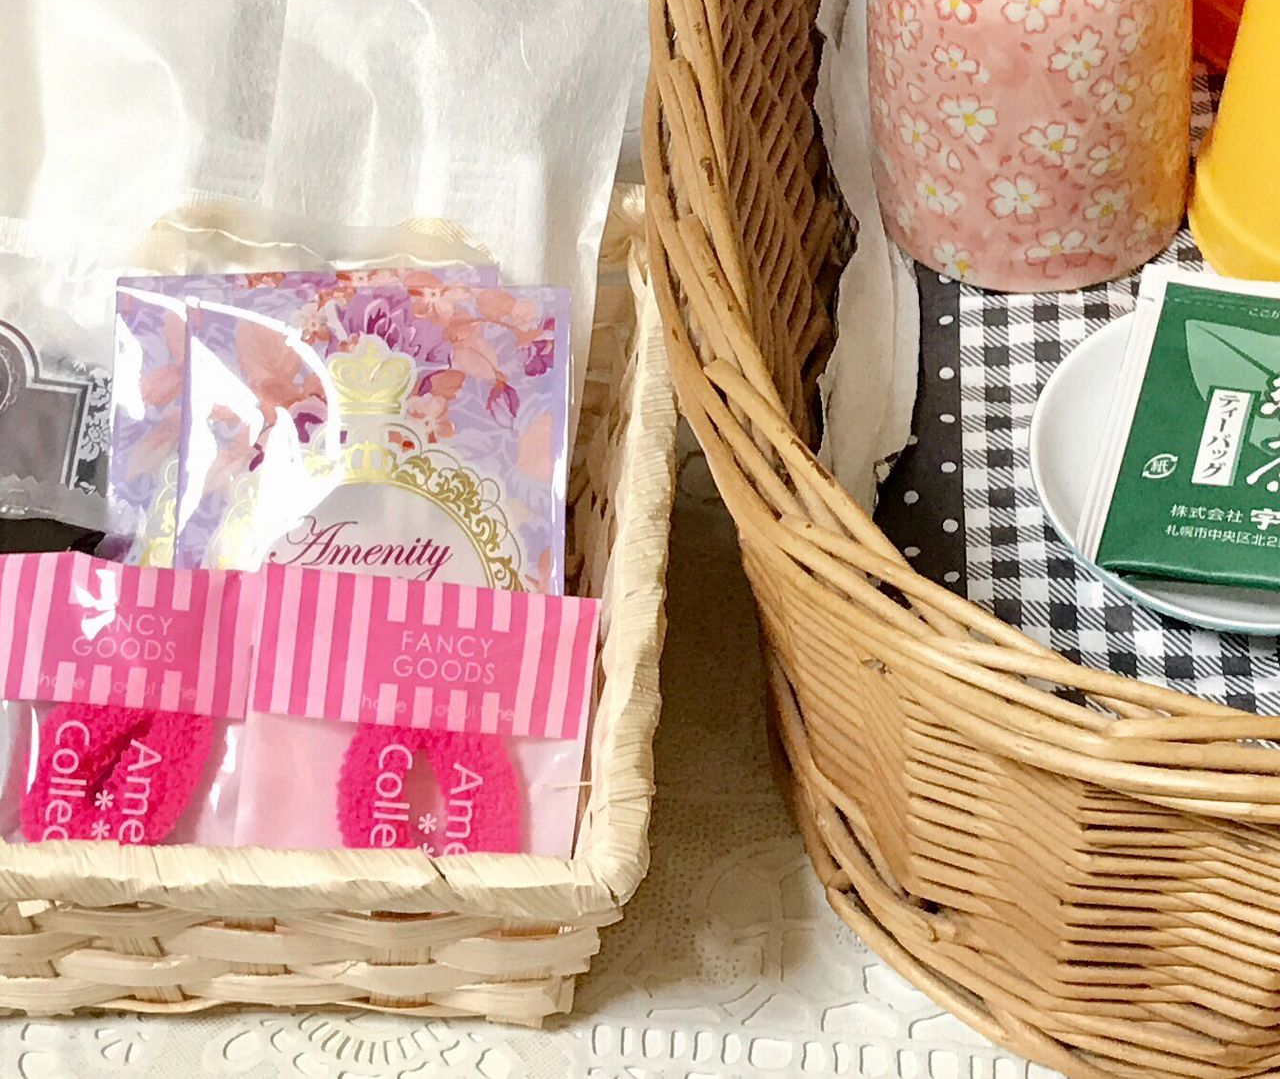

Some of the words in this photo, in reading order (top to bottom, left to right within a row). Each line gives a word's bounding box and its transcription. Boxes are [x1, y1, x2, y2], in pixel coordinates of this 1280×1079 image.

[1202, 394, 1241, 480] ティーバッグ
[1170, 504, 1244, 524] 株式会社
[270, 514, 454, 582] Amenity
[72, 635, 177, 663] GOODS
[401, 630, 494, 659] FANCY
[393, 654, 496, 685] GOODS
